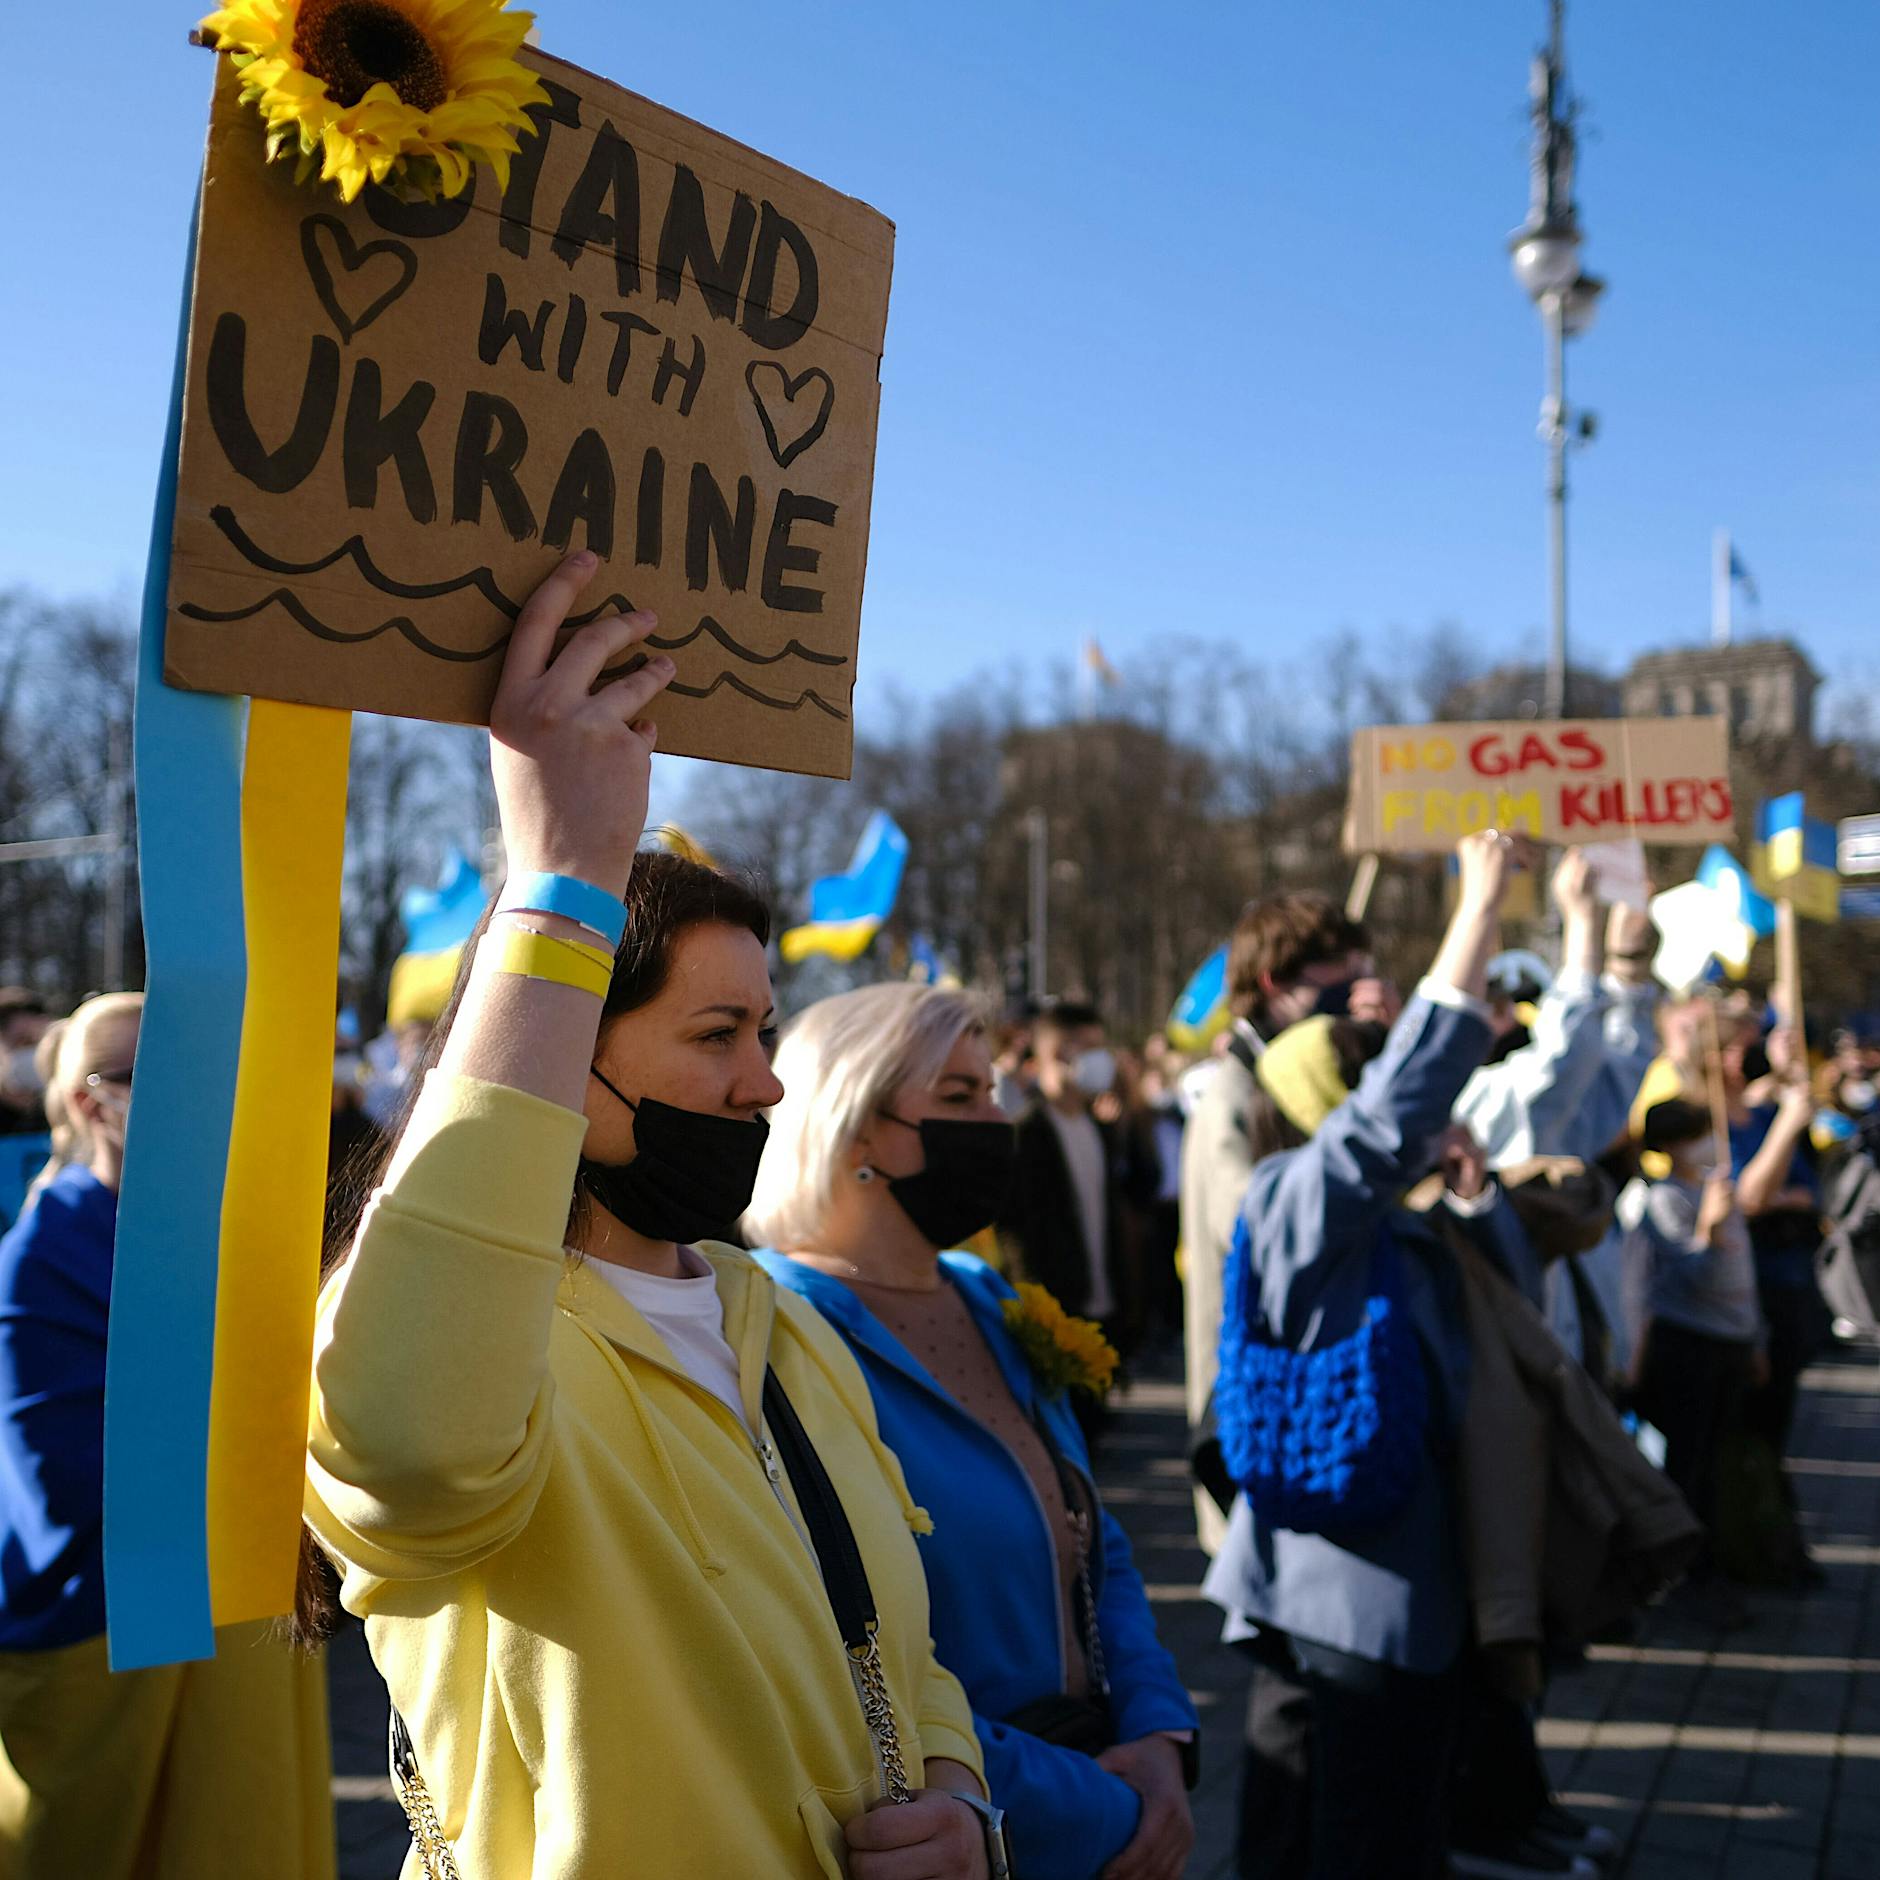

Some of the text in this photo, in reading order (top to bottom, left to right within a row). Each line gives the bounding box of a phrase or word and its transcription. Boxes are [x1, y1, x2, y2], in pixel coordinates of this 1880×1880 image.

[479, 273, 706, 416] WITH
[207, 311, 839, 612] UKRAINE
[1380, 731, 1605, 776] NO GAS
[1383, 779, 1732, 838] FROM KILLERS
